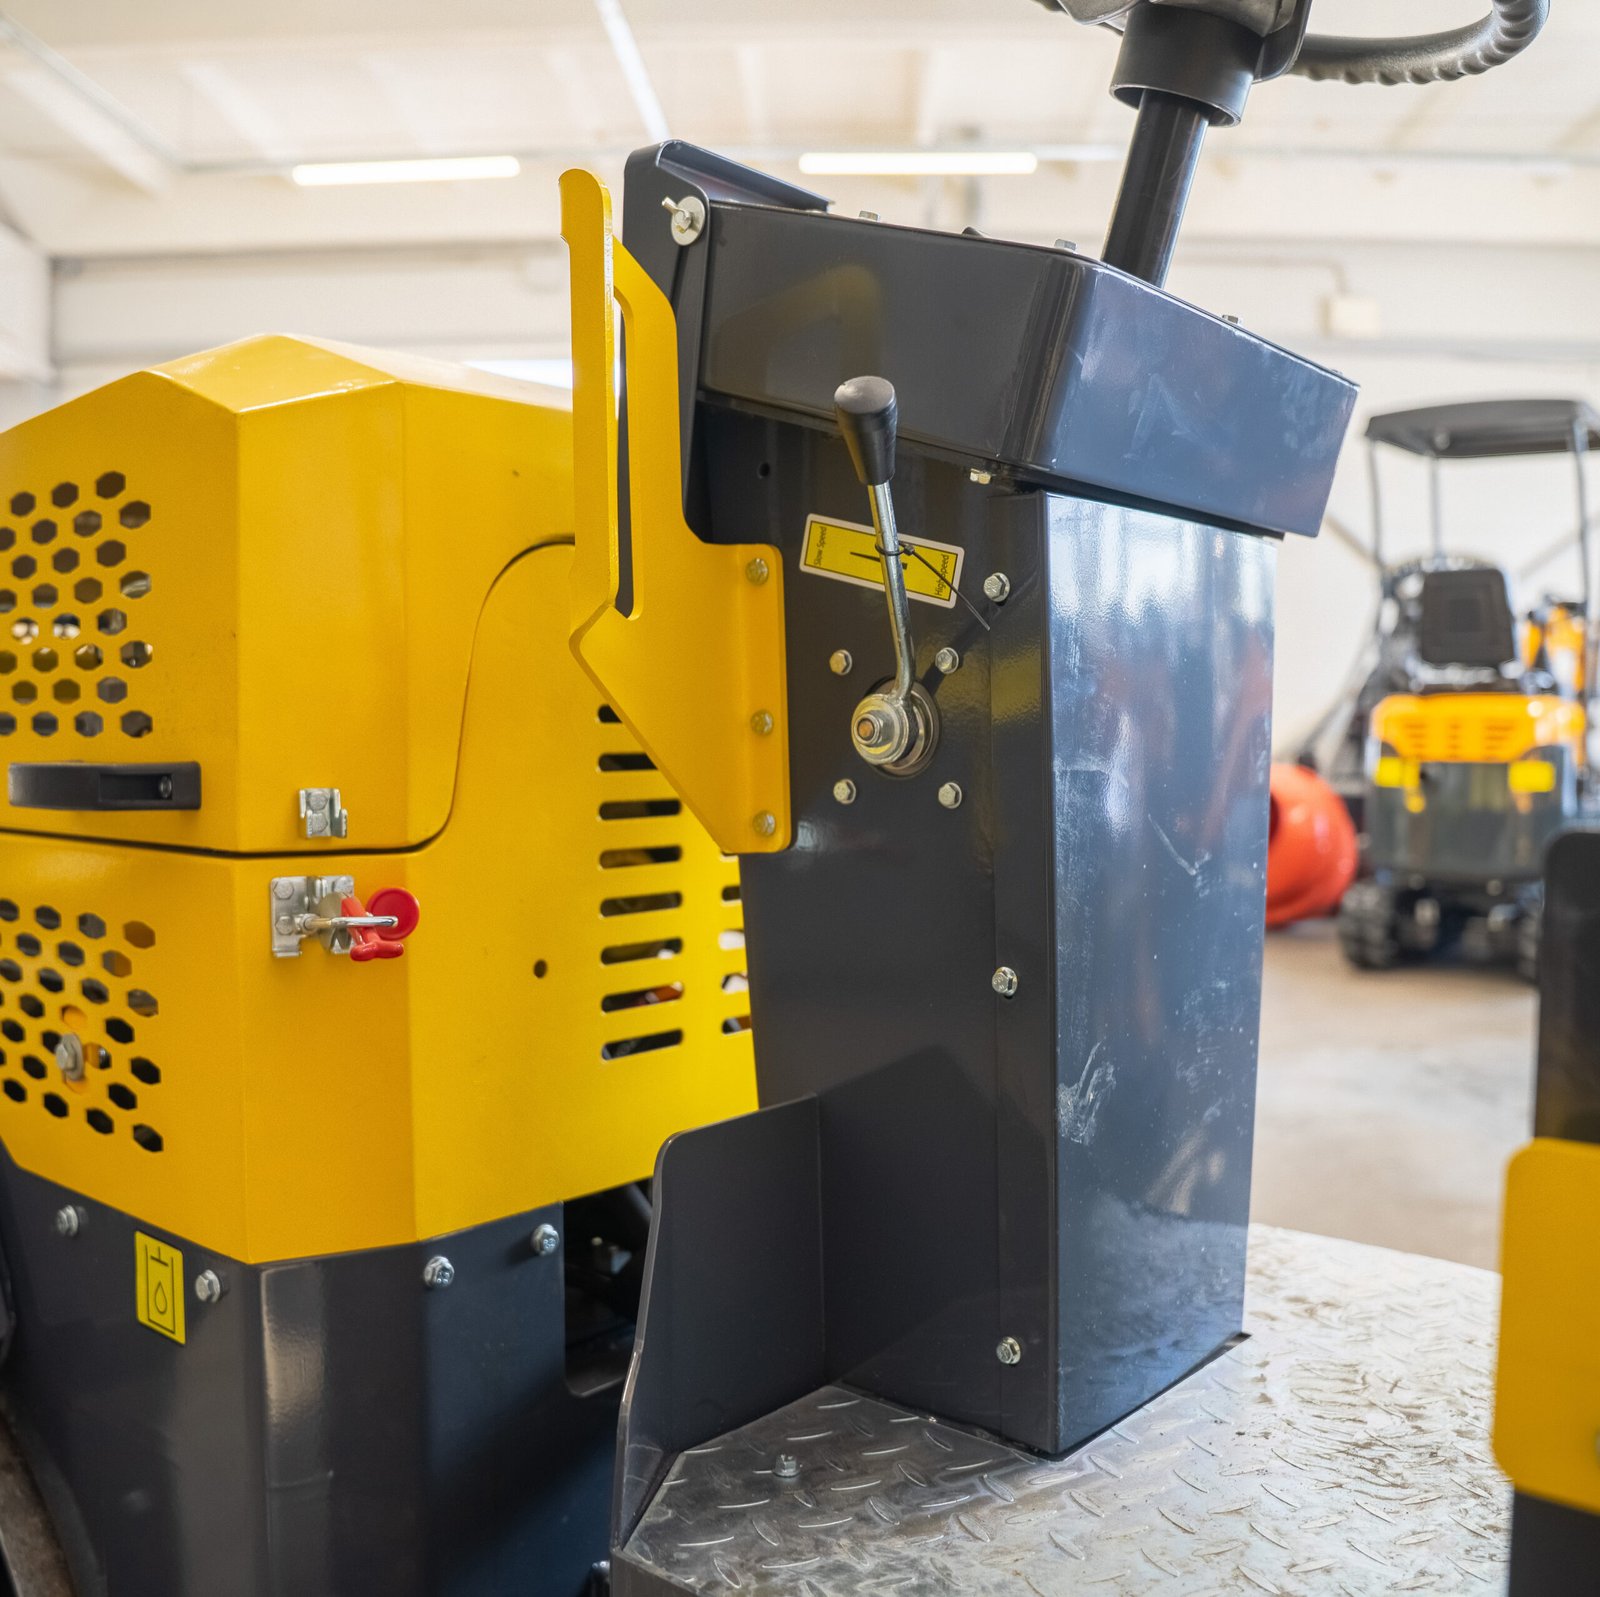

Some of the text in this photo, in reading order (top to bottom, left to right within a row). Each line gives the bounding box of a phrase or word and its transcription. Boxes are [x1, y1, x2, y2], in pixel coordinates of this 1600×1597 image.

[813, 526, 827, 566] Slow Speed
[934, 579, 946, 596] High
